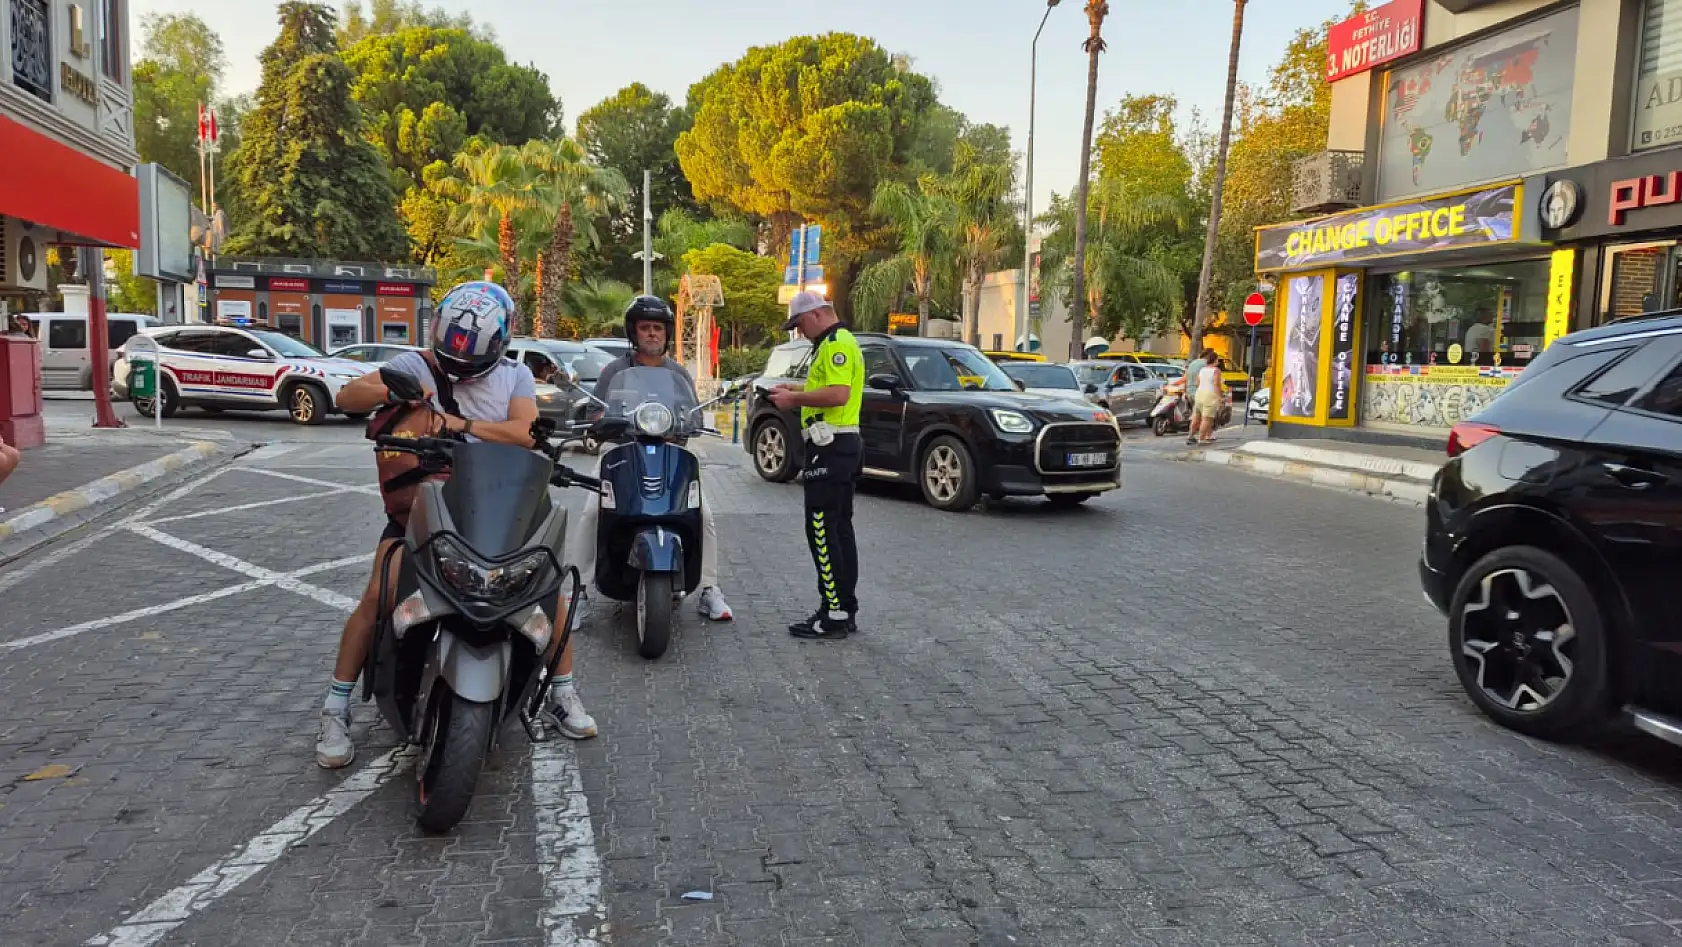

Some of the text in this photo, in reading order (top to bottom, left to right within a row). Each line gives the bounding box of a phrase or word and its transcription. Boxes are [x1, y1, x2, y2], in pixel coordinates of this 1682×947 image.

[1328, 17, 1415, 77] 3. NOTERLİĞİ
[1286, 204, 1466, 257] CHANGE OFFICE
[1335, 282, 1354, 410] CHANGE OFFICE
